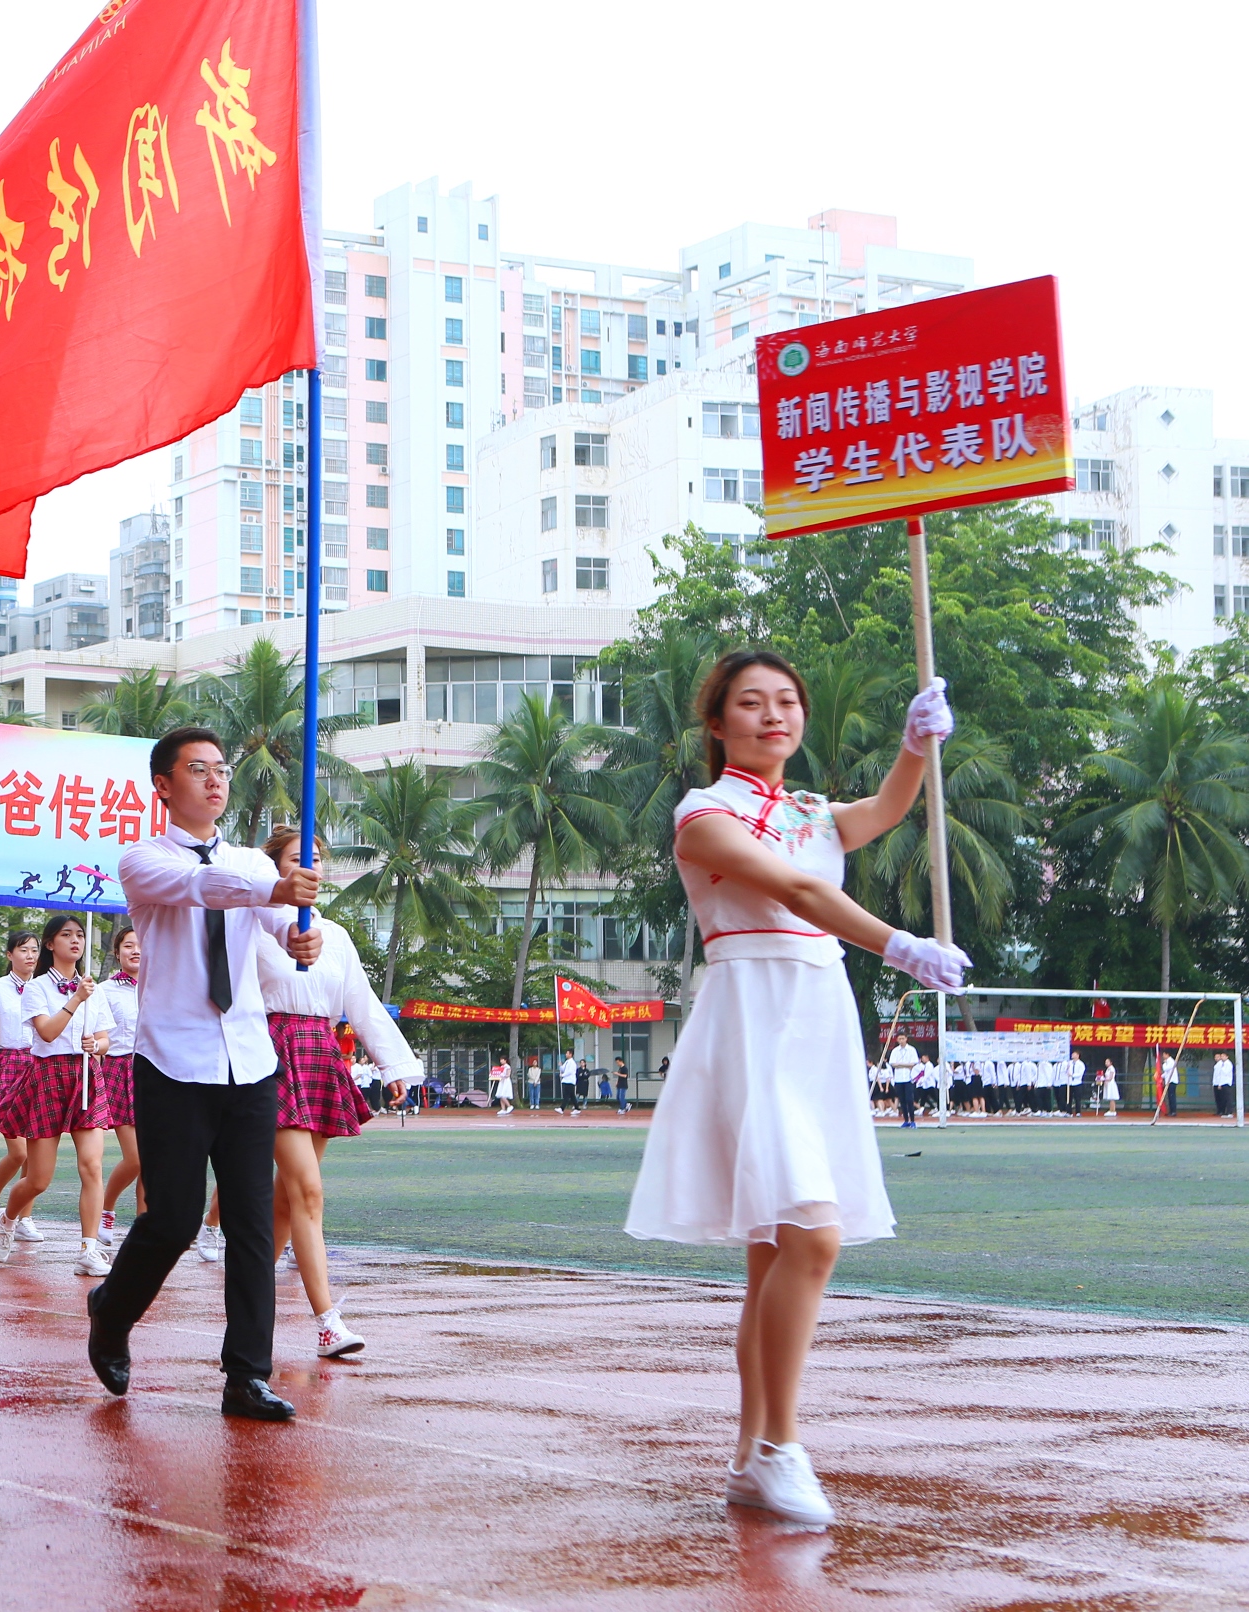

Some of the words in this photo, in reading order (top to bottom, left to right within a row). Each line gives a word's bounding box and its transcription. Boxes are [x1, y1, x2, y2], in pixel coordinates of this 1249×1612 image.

[815, 325, 918, 358] 海南师范大学
[815, 358, 845, 368] HAINAN
[845, 350, 876, 362] NORMAL
[876, 343, 918, 357] UNIVERSITY
[776, 351, 1050, 440] 新闻传播与影视学院
[794, 413, 1037, 494] 学生代表队
[413, 1002, 529, 1021] 流血流汗不流泪
[1145, 1025, 1249, 1044] 拼搏赢得未
